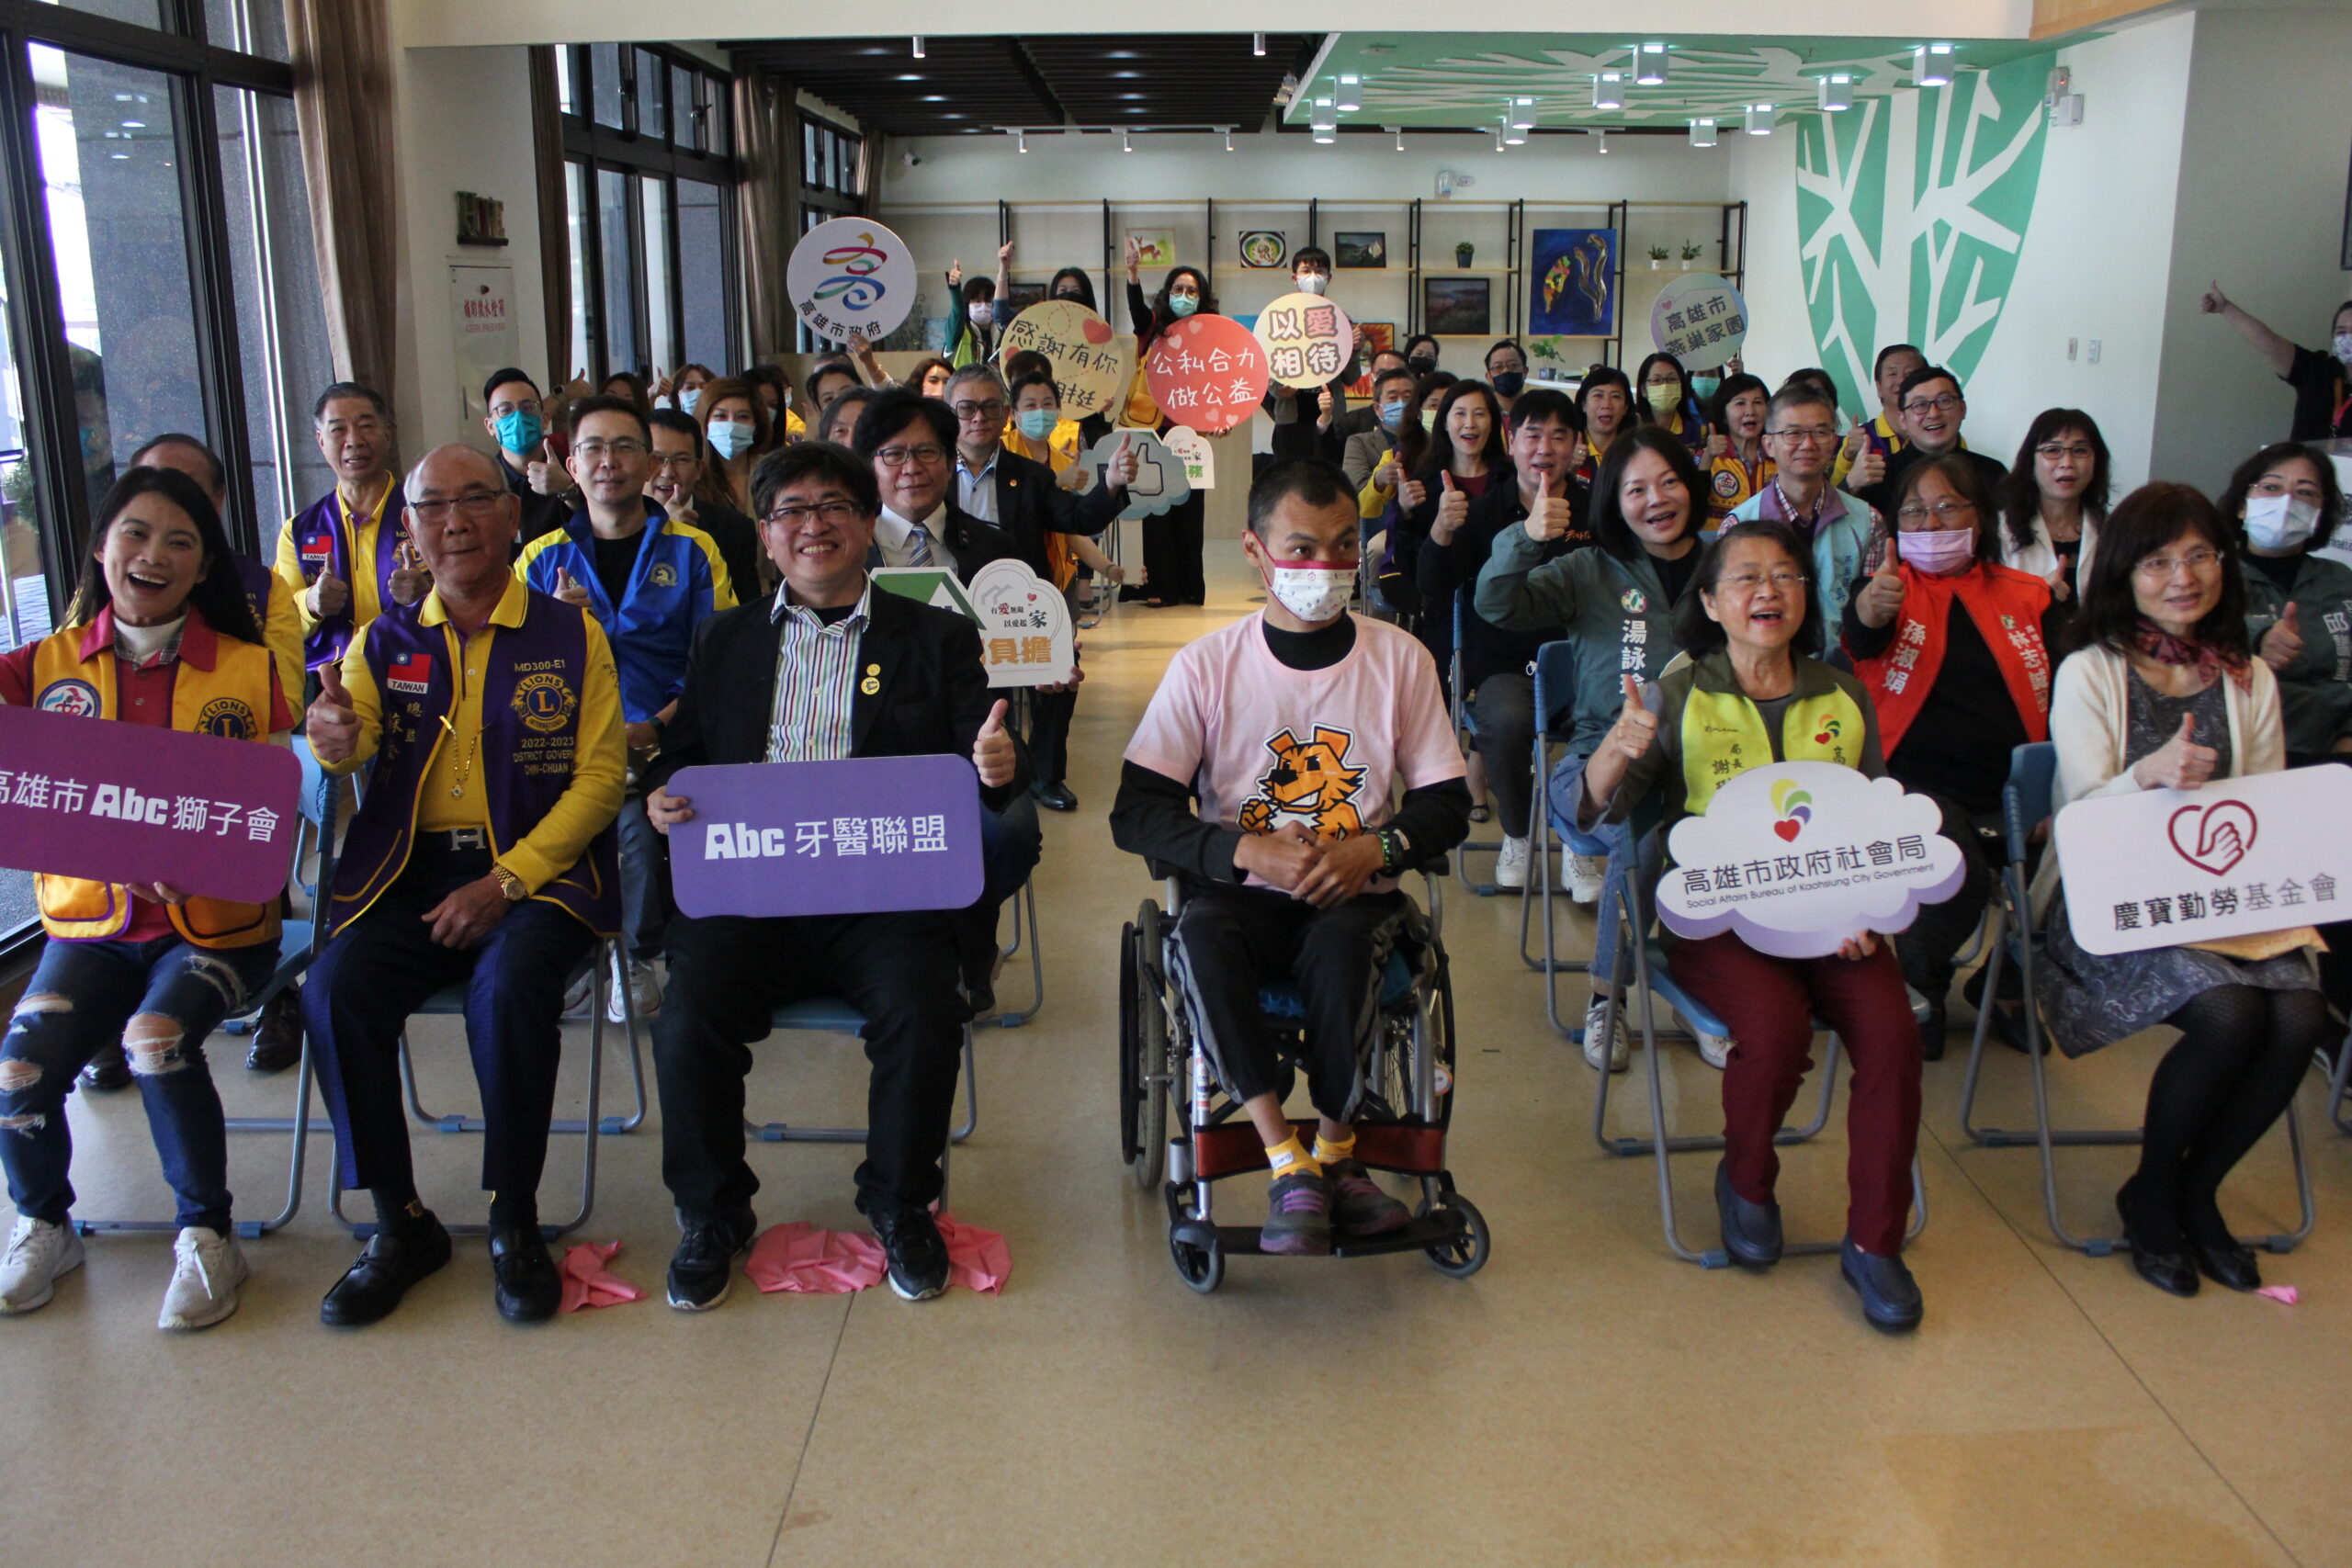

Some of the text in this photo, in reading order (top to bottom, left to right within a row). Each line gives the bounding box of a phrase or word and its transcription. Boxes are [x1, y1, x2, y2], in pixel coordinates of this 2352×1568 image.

[798, 299, 882, 337] 高雄市政府
[1269, 305, 1338, 341] 以愛
[1665, 296, 1726, 333] 高雄市
[1009, 319, 1118, 374] 感謝有你
[1665, 314, 1745, 357] 燕巢家園
[1153, 346, 1255, 376] 公私合力
[1272, 341, 1340, 378] 相待
[1167, 376, 1258, 410] 做公益
[305, 553, 327, 561] TAIWA
[514, 659, 566, 672] MD300-E1
[980, 636, 1052, 666] 負擔
[1882, 618, 1927, 695] 孫淑娟
[391, 680, 425, 694] TAIWAN
[524, 674, 561, 690] LIONS
[209, 701, 249, 716] LIONS
[536, 690, 555, 713] L
[513, 750, 544, 763] DISTRICT
[521, 736, 575, 749] 2022-2023
[1730, 743, 1745, 770] 局長
[705, 814, 948, 861] Abc 牙醫聯盟
[1682, 833, 1928, 897] 高雄市政府社會局
[1686, 863, 1935, 909] Social Affairs Bureau of Kaohsiung City Government
[2113, 872, 2336, 931] 慶寶勤勞基金會
